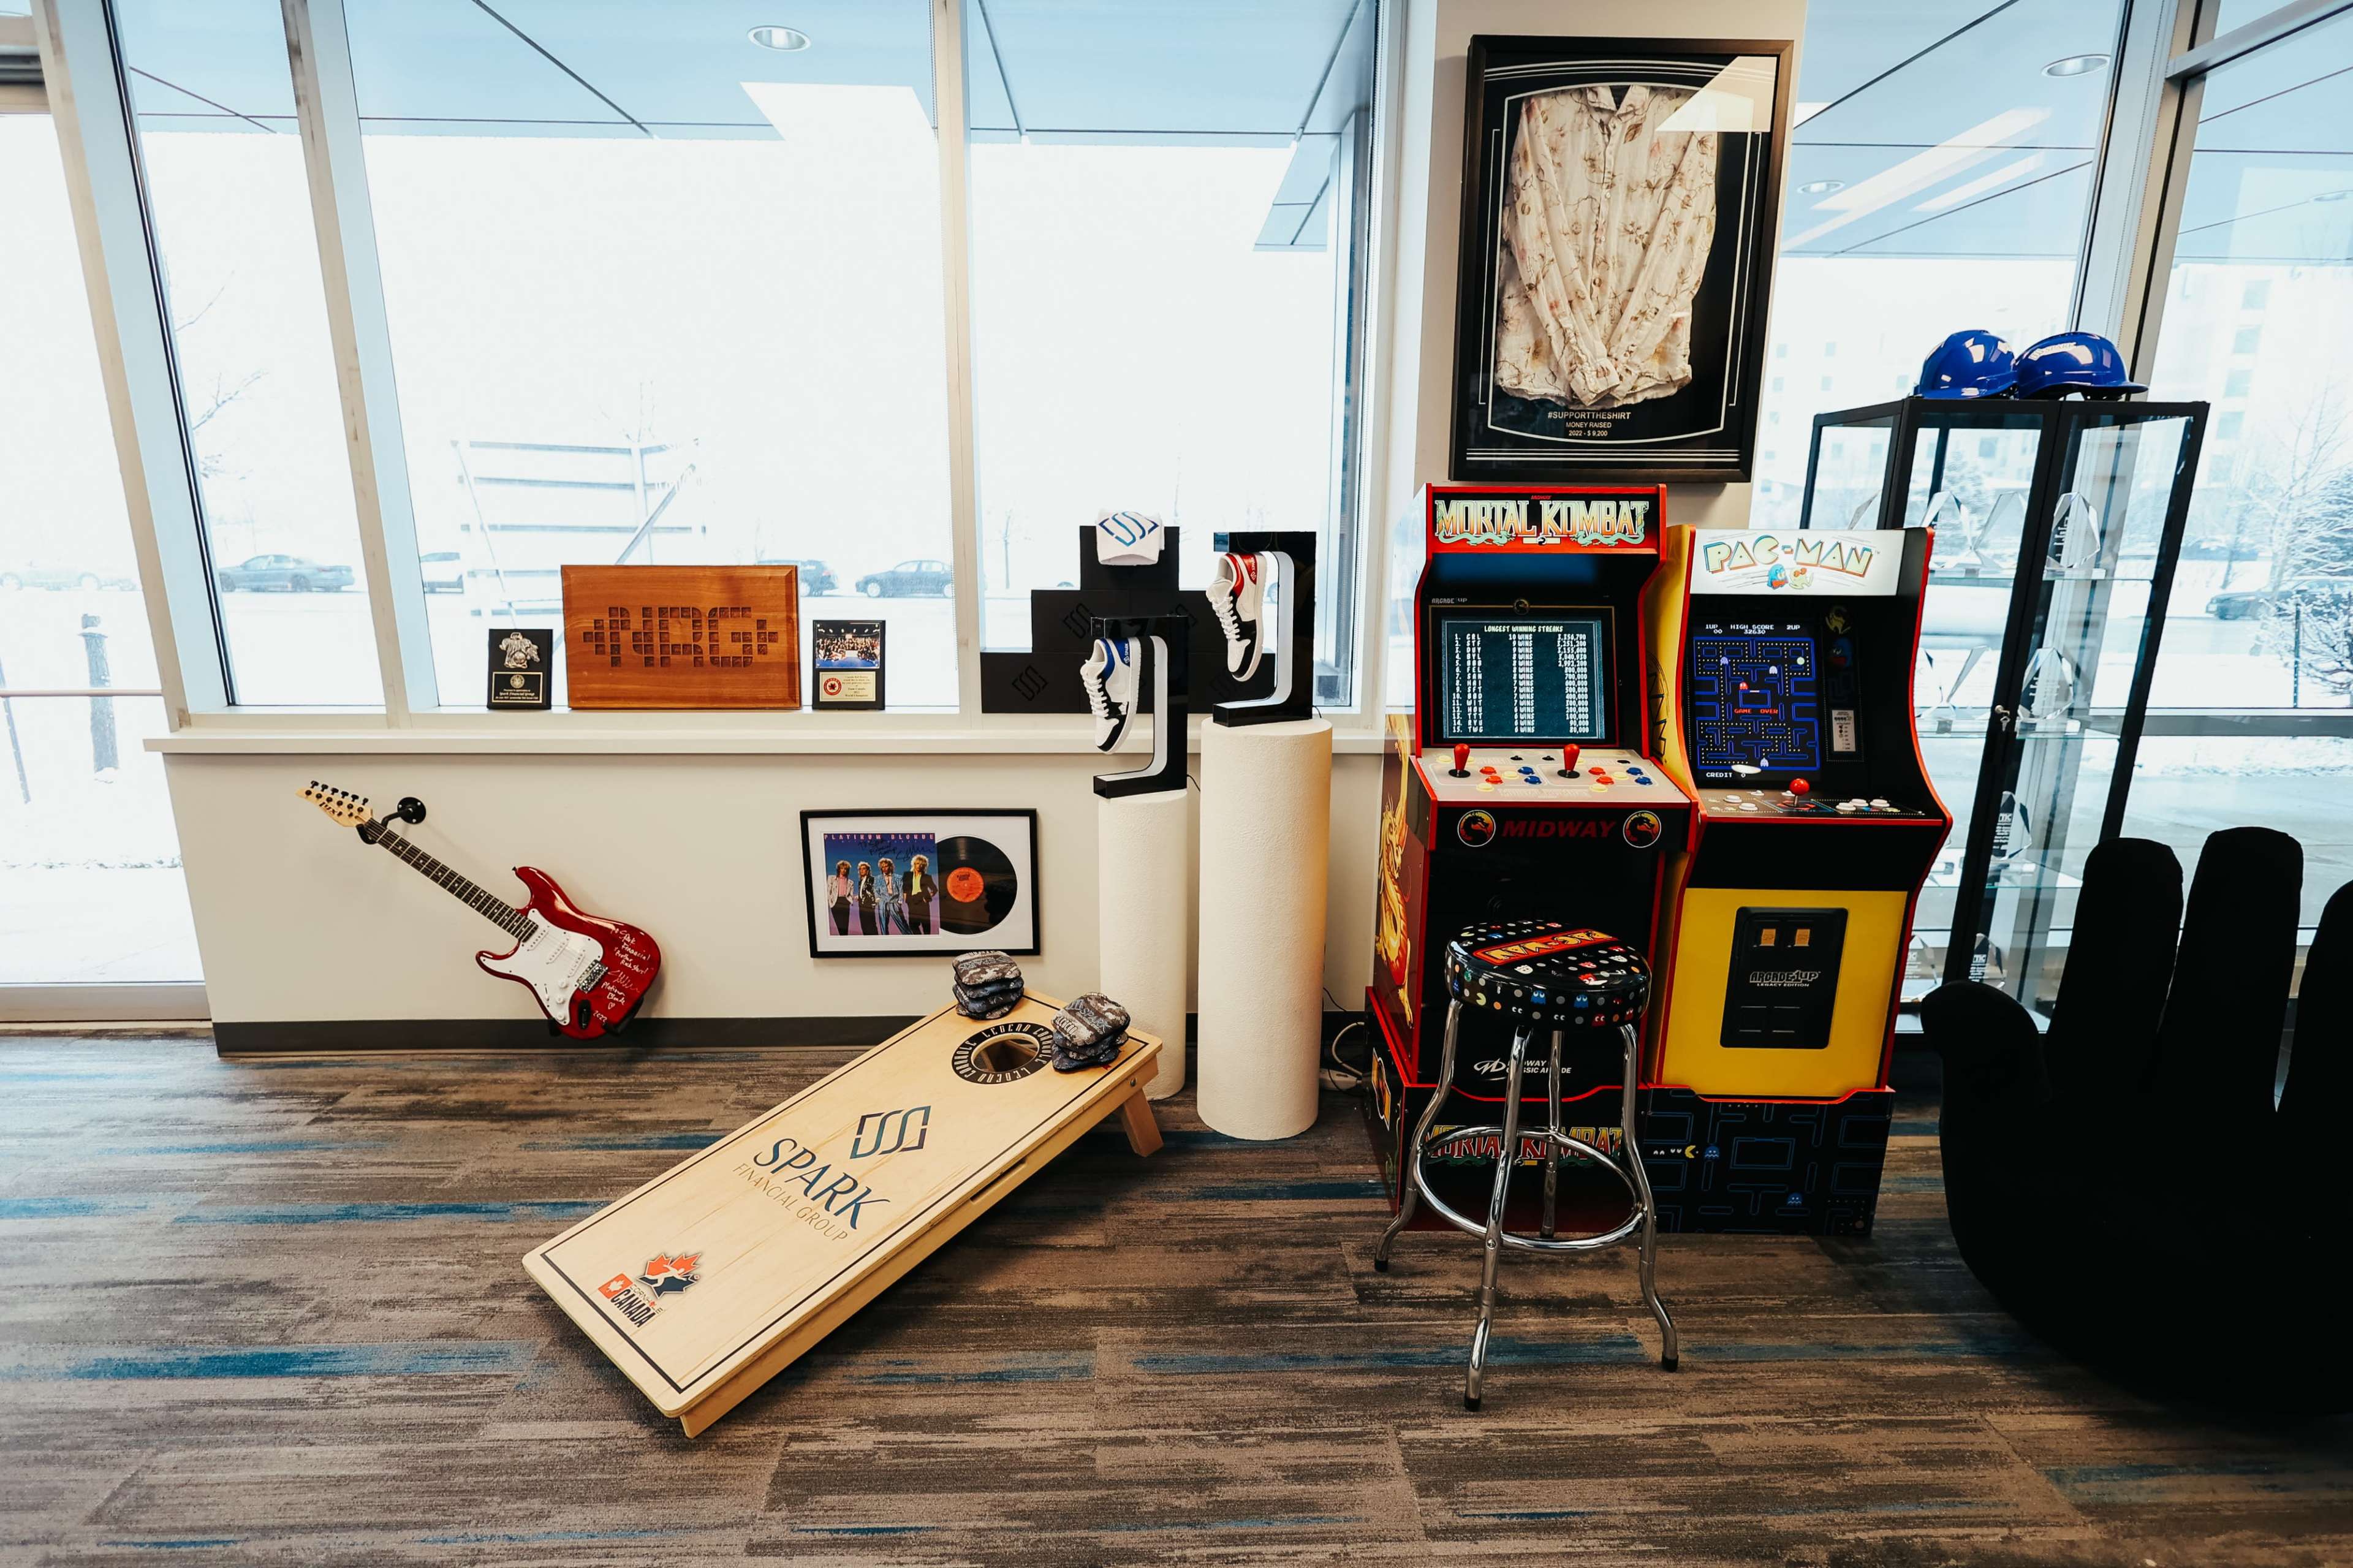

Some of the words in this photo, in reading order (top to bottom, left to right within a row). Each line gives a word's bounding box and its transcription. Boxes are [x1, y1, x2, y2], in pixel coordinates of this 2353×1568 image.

[1547, 411, 1631, 420] #SUPPORTTHESHIRT
[1434, 500, 1537, 537] MORTAL
[1539, 500, 1650, 538] KOMBAT
[1703, 534, 1873, 578] PAC-MAN
[1501, 820, 1617, 838] MIDWAY
[1485, 930, 1613, 960] PAC-MAN
[732, 1163, 798, 1211] FINANCIAL
[796, 1206, 848, 1241] GROUP
[753, 1138, 891, 1230] SPARK
[610, 1288, 656, 1328] CANADA
